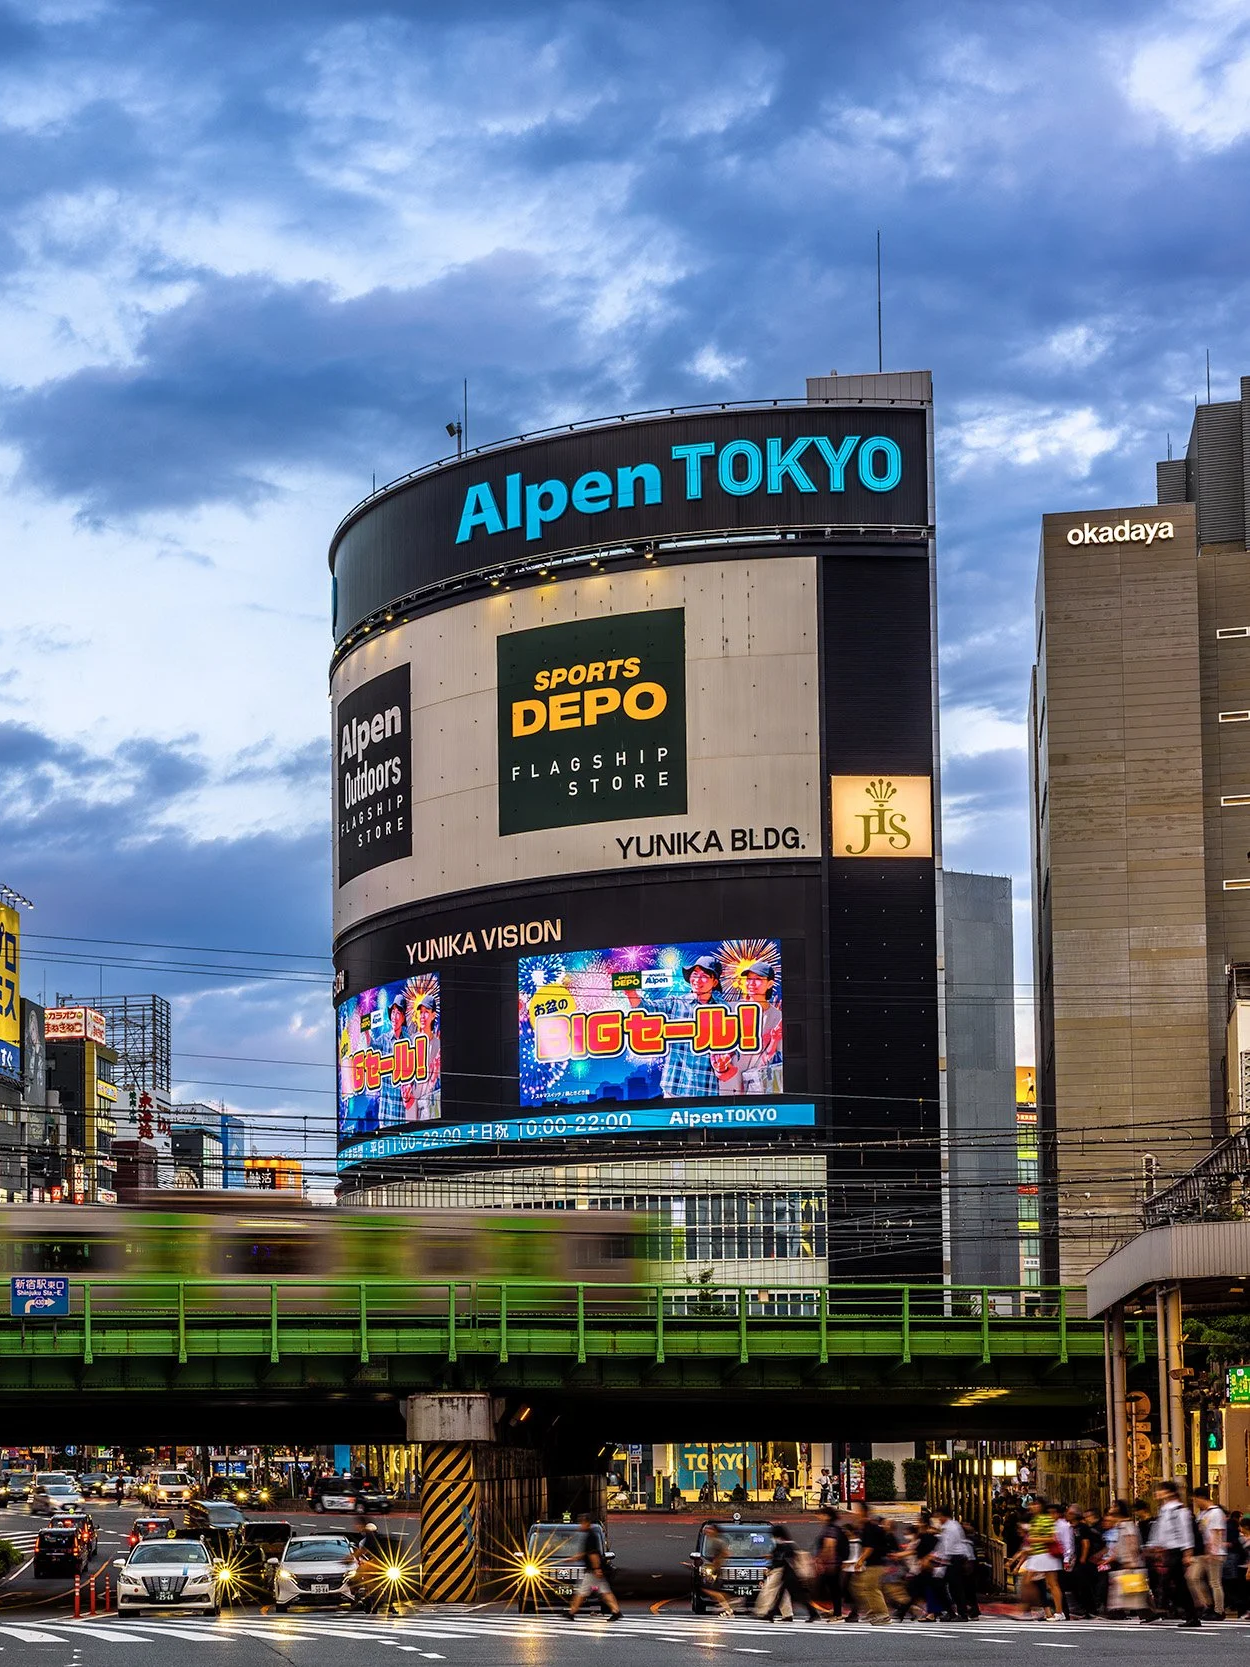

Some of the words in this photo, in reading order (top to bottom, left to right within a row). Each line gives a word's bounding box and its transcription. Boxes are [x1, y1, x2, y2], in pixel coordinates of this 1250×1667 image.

[455, 461, 664, 545] Alpen
[671, 434, 903, 500] TOKYO
[1066, 519, 1175, 546] okadaya
[533, 656, 642, 692] SPORTS
[510, 682, 669, 738] DEPO
[340, 705, 402, 766] Alpen
[511, 746, 671, 782] FLAGSHIP
[344, 756, 402, 810] Outdoors
[567, 770, 671, 797] STORE
[340, 794, 404, 838] FLAGSHIP
[358, 816, 404, 848] STORE
[616, 830, 725, 861] YUNIKA
[730, 826, 807, 854] BLDG.
[405, 931, 478, 966] YUNIKA
[481, 918, 563, 952] VISION
[613, 978, 640, 987] DEPO
[645, 976, 669, 985] Alpen
[48, 1011, 77, 1020] カラオケ
[533, 998, 569, 1016] お盆の
[44, 1021, 83, 1035] まねきねこ
[669, 1109, 724, 1127] Alpen
[725, 1108, 778, 1123] TOKYO
[467, 1123, 510, 1144] 土日祝
[14, 1279, 65, 1290] 新宿駅東口
[16, 1289, 42, 1297] Shinjuku
[684, 1453, 749, 1471] TOKYO
